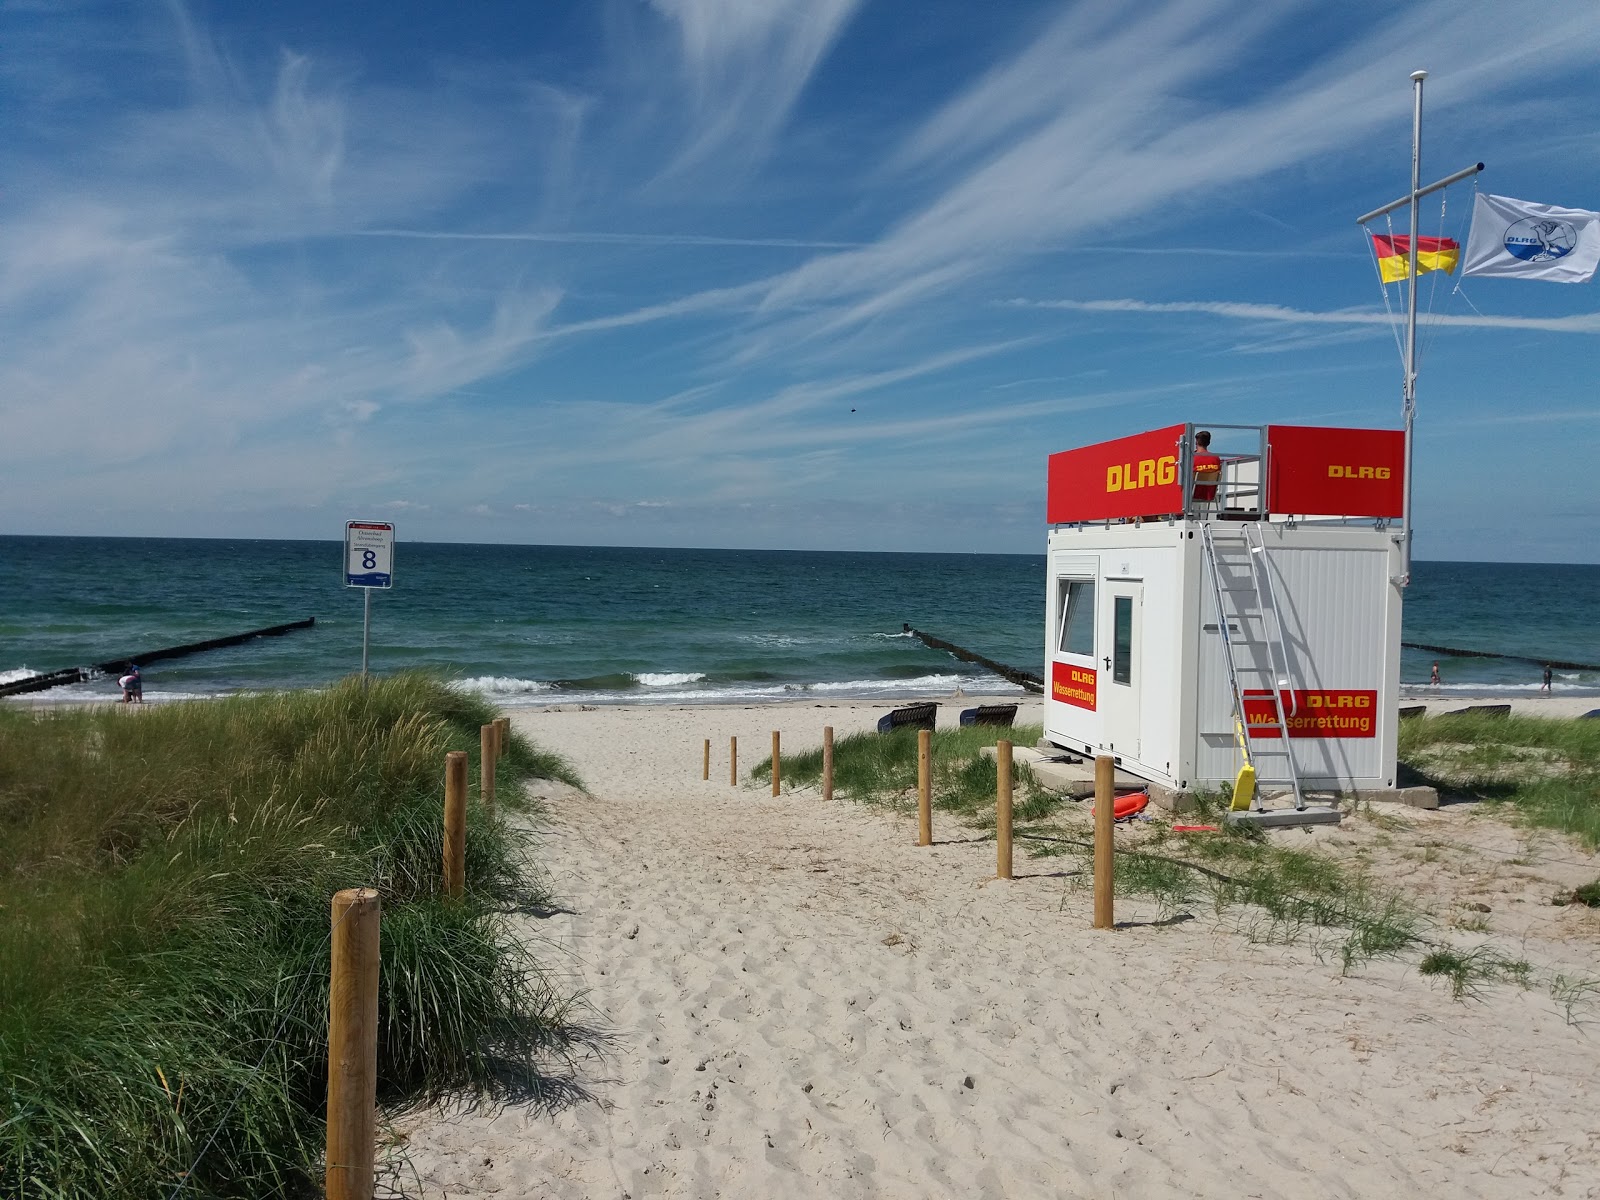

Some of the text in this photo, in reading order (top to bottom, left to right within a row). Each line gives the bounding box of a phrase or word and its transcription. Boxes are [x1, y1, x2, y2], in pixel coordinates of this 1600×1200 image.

[1506, 236, 1538, 244] DLRG
[1106, 455, 1175, 493] DLRG
[1328, 465, 1391, 480] DLRG
[362, 550, 376, 569] 8
[1071, 670, 1095, 685] DLRG
[1053, 681, 1095, 706] Wasserrettung
[1307, 695, 1370, 708] DLRG
[1250, 713, 1370, 732] Waserrettung
